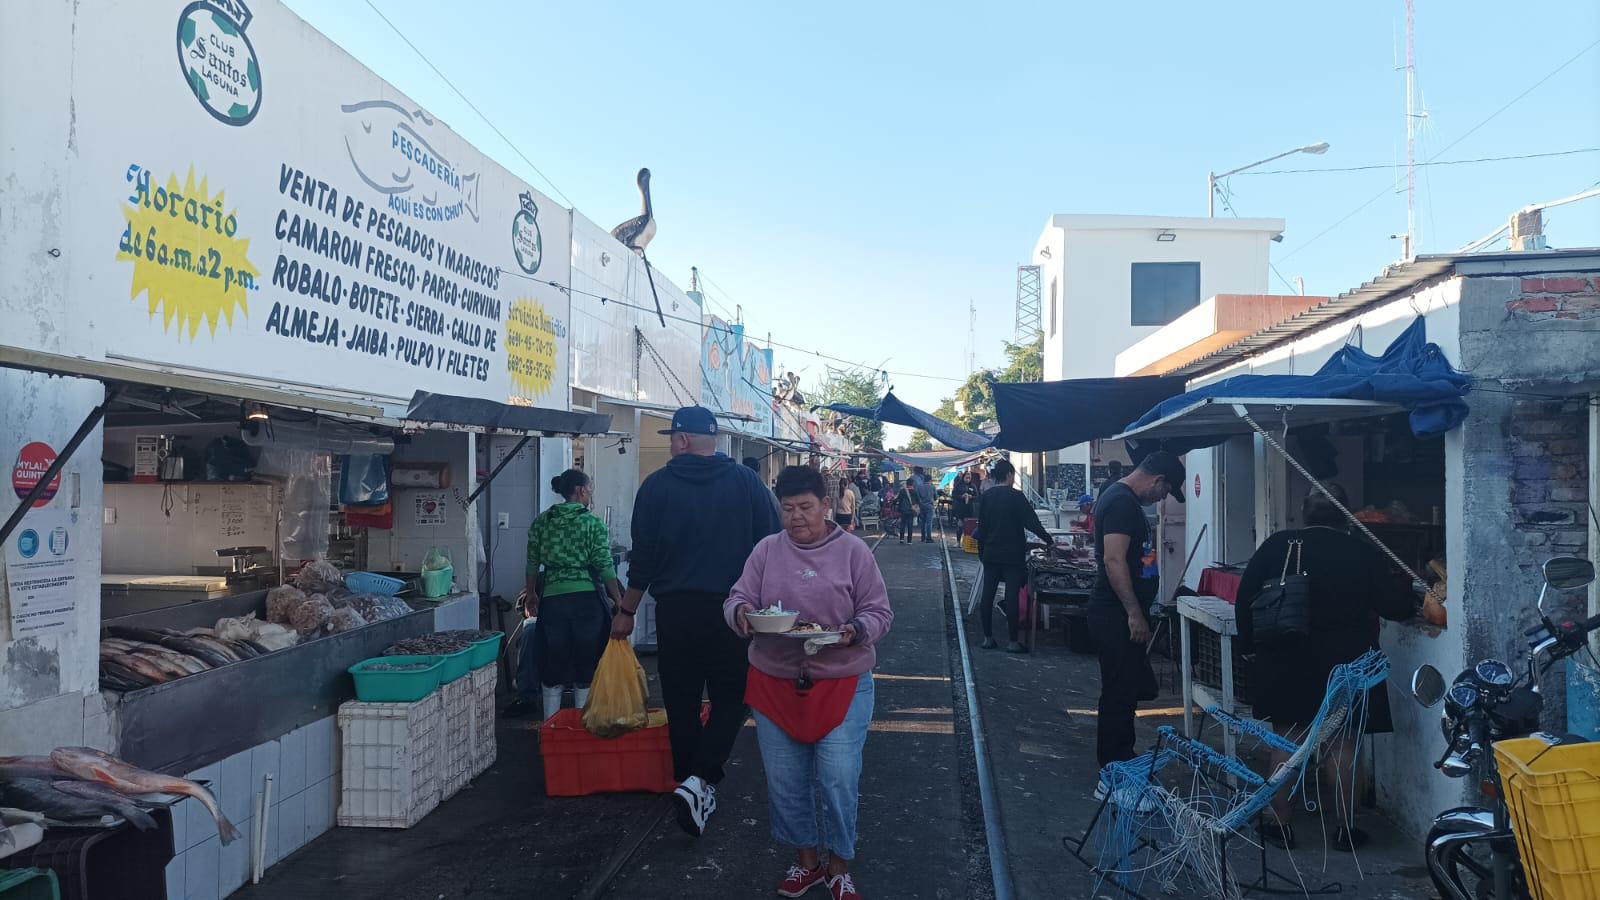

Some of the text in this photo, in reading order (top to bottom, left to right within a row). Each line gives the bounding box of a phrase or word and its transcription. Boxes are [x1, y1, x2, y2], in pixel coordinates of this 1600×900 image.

[190, 37, 247, 88] Santos
[210, 34, 235, 58] CLUB
[202, 65, 239, 98] LAGUNA
[392, 130, 461, 193] PESCADERÍA
[126, 164, 238, 238] Horario
[279, 162, 500, 291] VENTA DE PESCADOS Y MARISCOS
[413, 202, 424, 219] ES
[425, 206, 443, 221] CON
[444, 199, 464, 221] CHUY
[275, 209, 501, 322] CAMARON FRESCO PARGO CURVINA
[272, 254, 497, 352] ROBALO BOTETE SIERRA CALLO DE
[265, 301, 490, 382] ALMEJA JAIBA PULPO Y FILETES
[16, 470, 58, 481] QUINT
